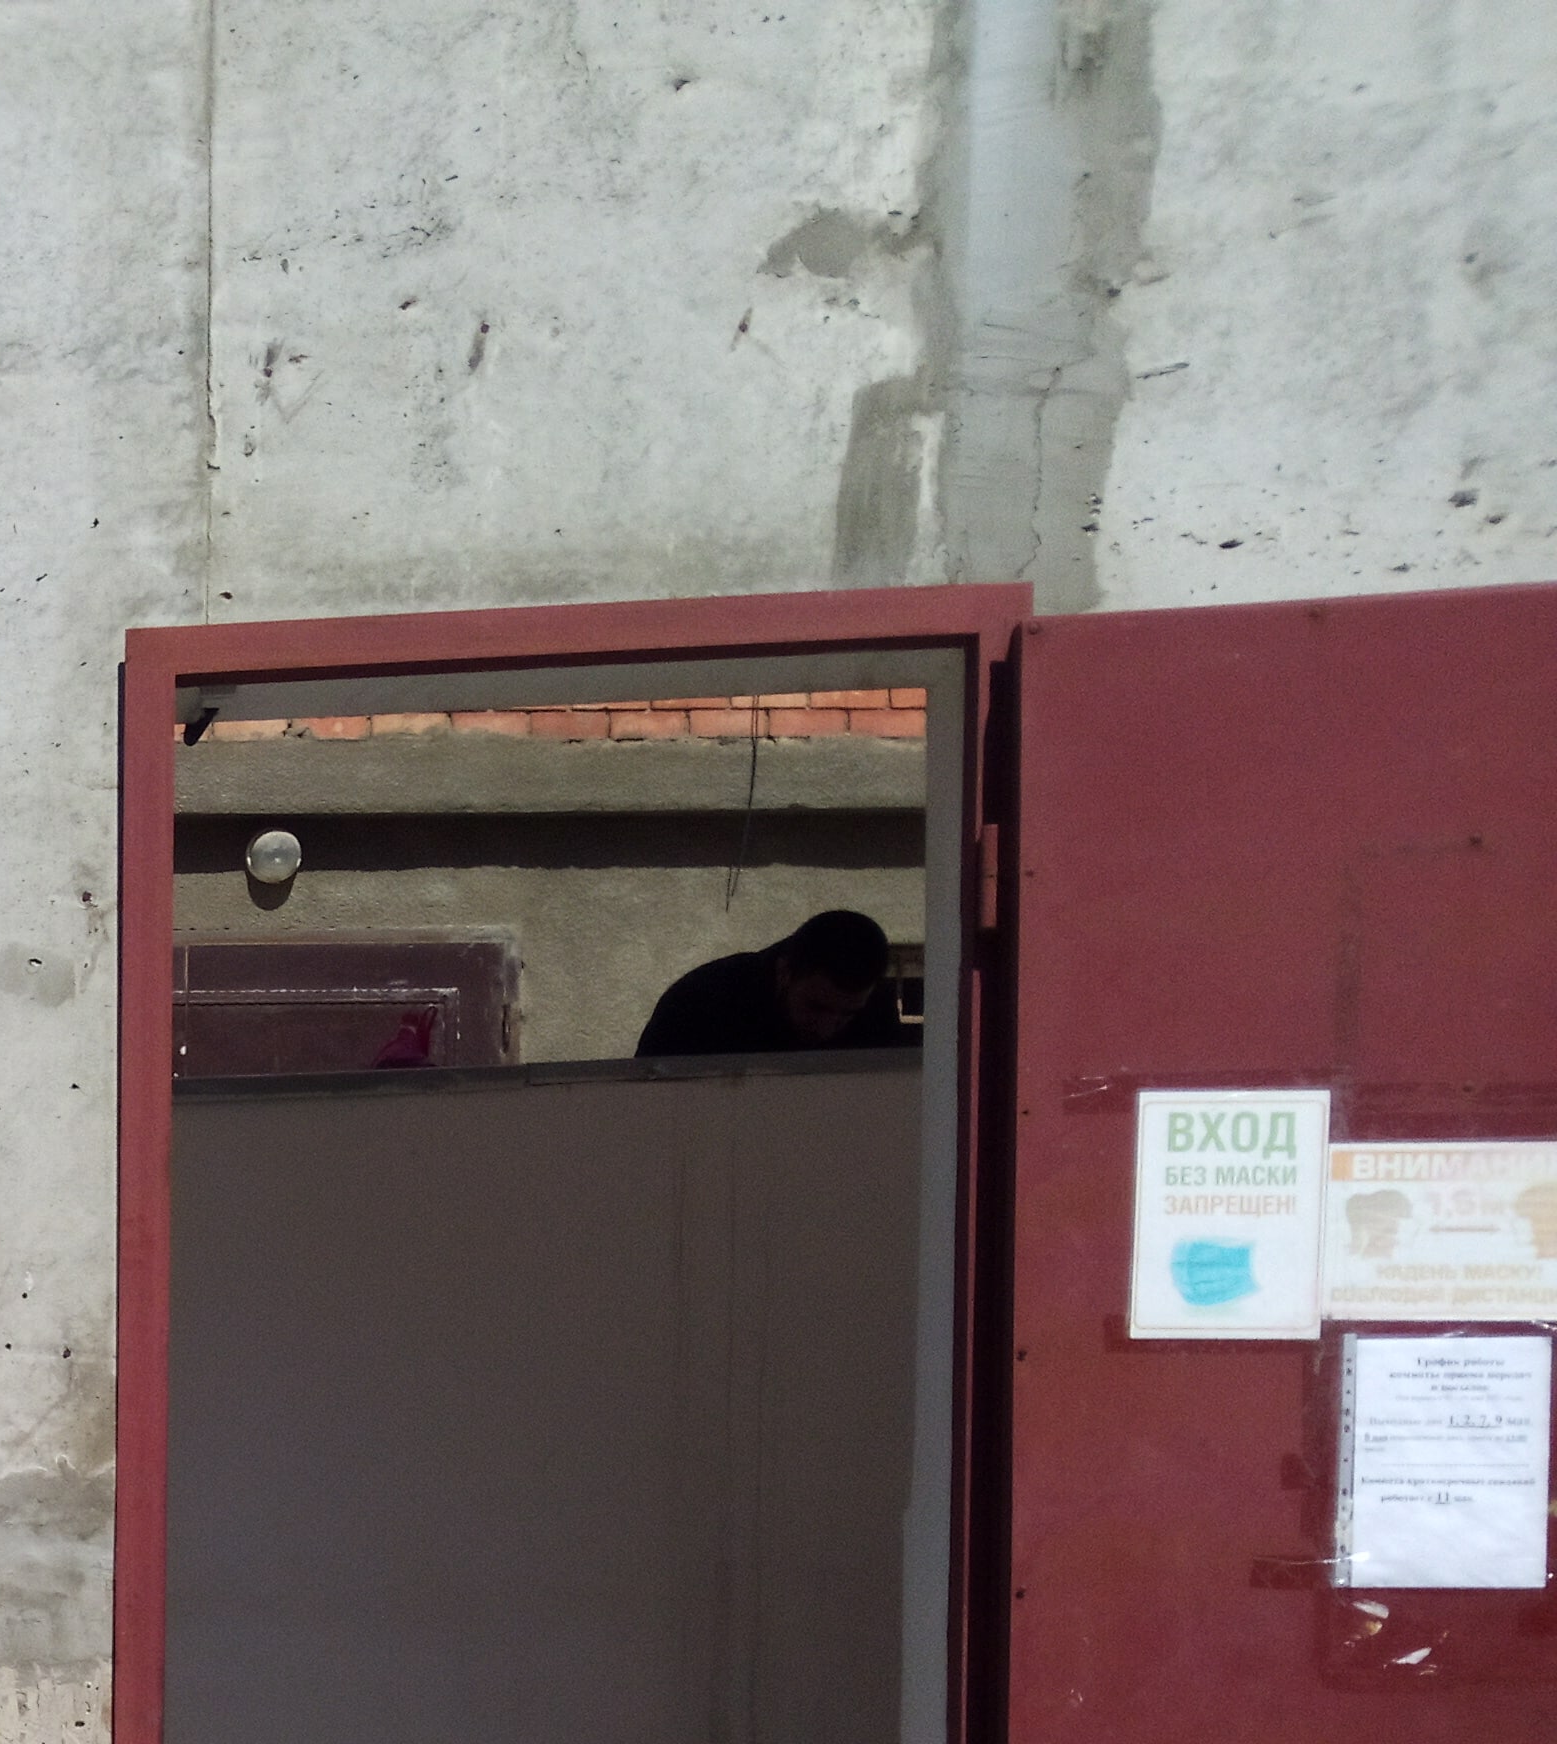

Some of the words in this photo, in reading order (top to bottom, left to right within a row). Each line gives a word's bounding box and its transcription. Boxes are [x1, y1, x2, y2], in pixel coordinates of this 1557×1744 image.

[1166, 1110, 1297, 1158] ВХОД
[1164, 1166, 1206, 1187] БЕЗ
[1215, 1164, 1298, 1186] МАСКИ
[1163, 1194, 1297, 1218] ЗАПРЕЩЕН!
